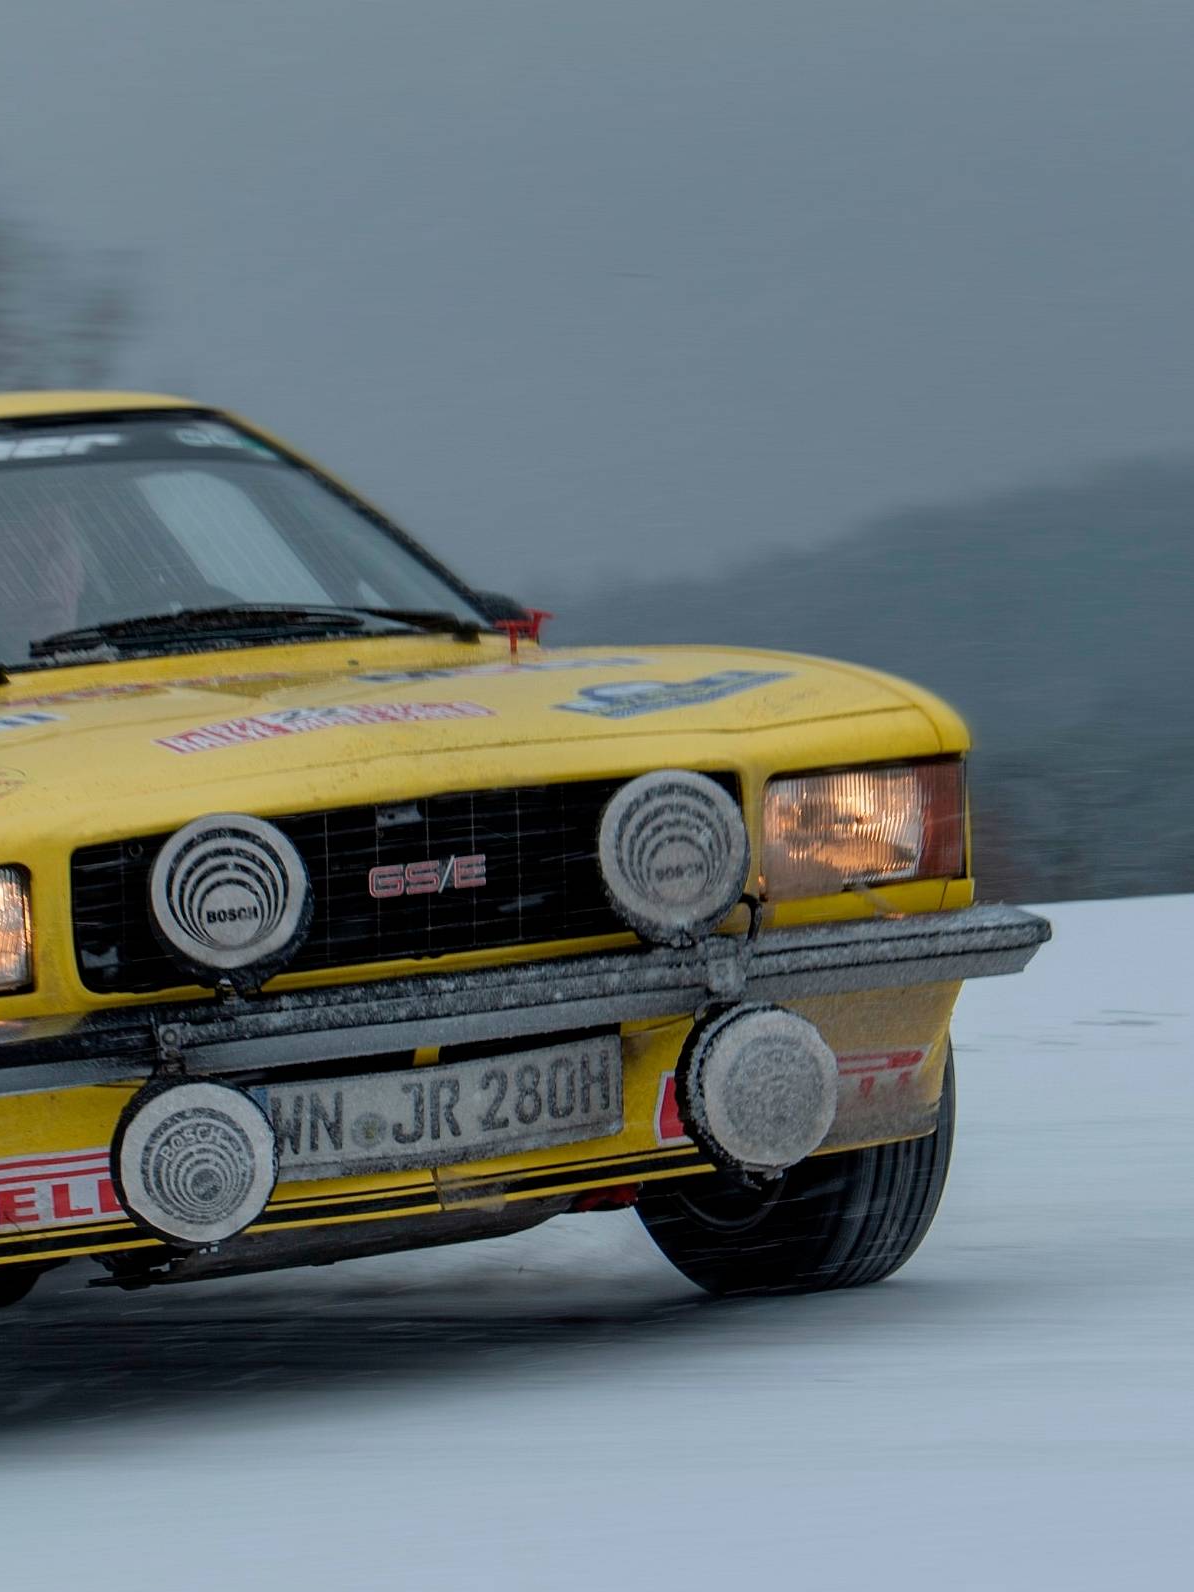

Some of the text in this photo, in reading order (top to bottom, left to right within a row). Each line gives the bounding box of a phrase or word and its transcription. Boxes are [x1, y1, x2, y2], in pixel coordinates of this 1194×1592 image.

[206, 906, 259, 924] BOSCH
[270, 1091, 344, 1156] WN
[392, 1077, 462, 1145] JR
[480, 1050, 612, 1133] 280H
[159, 1125, 230, 1162] BOSCH
